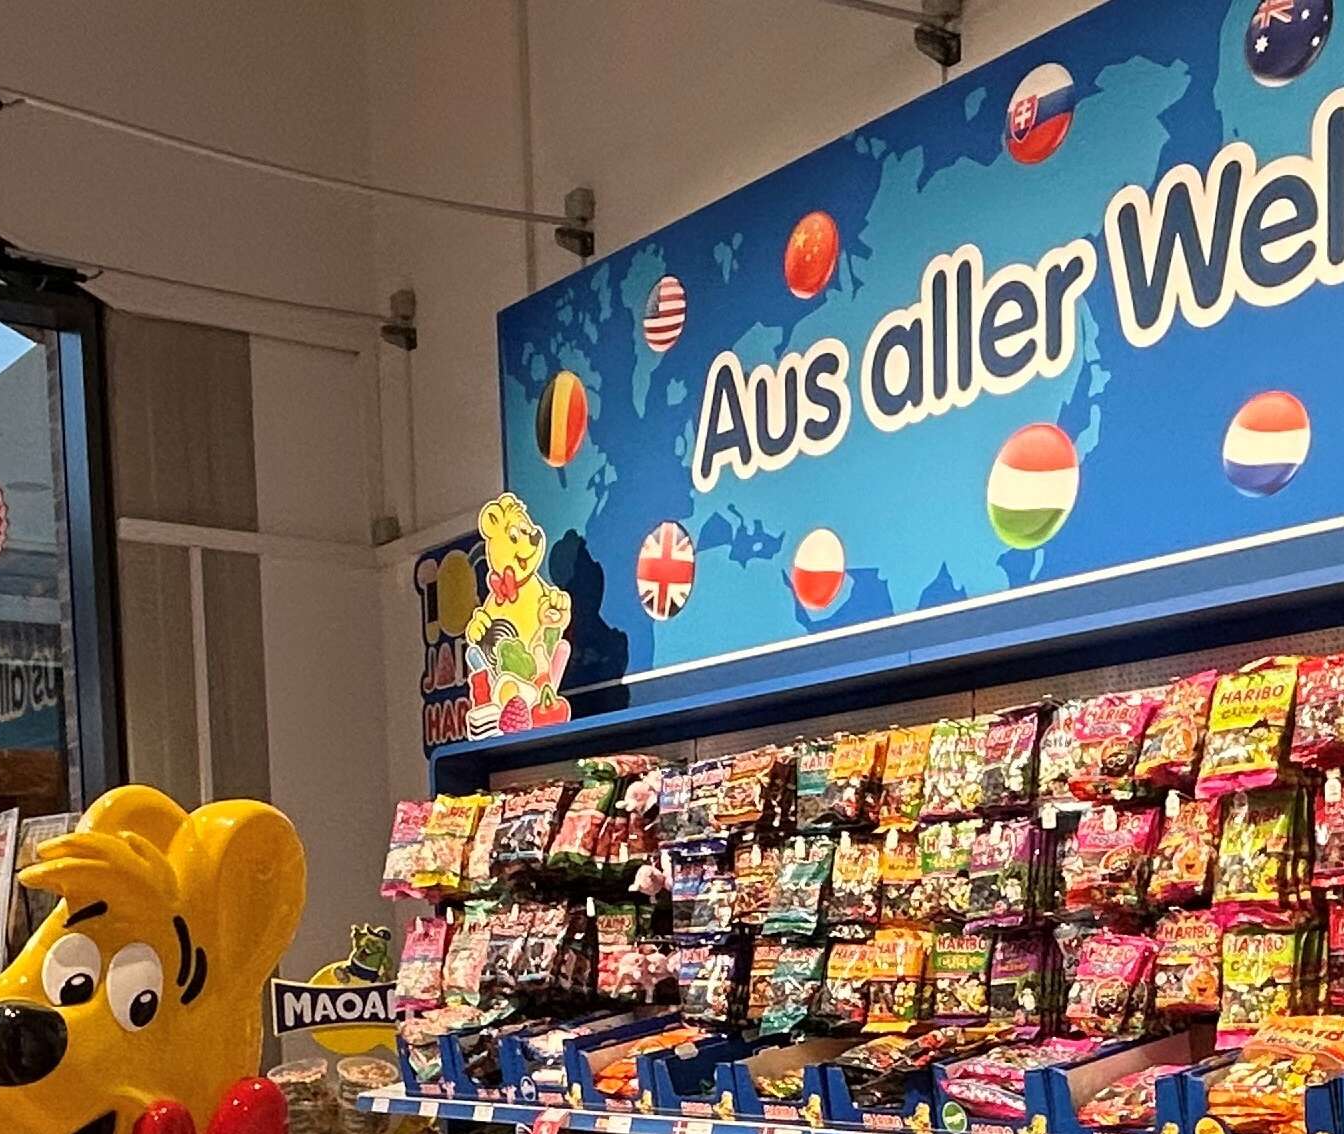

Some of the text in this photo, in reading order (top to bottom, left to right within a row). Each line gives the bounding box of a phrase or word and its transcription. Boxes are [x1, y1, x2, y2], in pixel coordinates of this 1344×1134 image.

[692, 346, 848, 492] Aus
[863, 241, 1096, 432] aller
[1219, 684, 1284, 706] HARIBO
